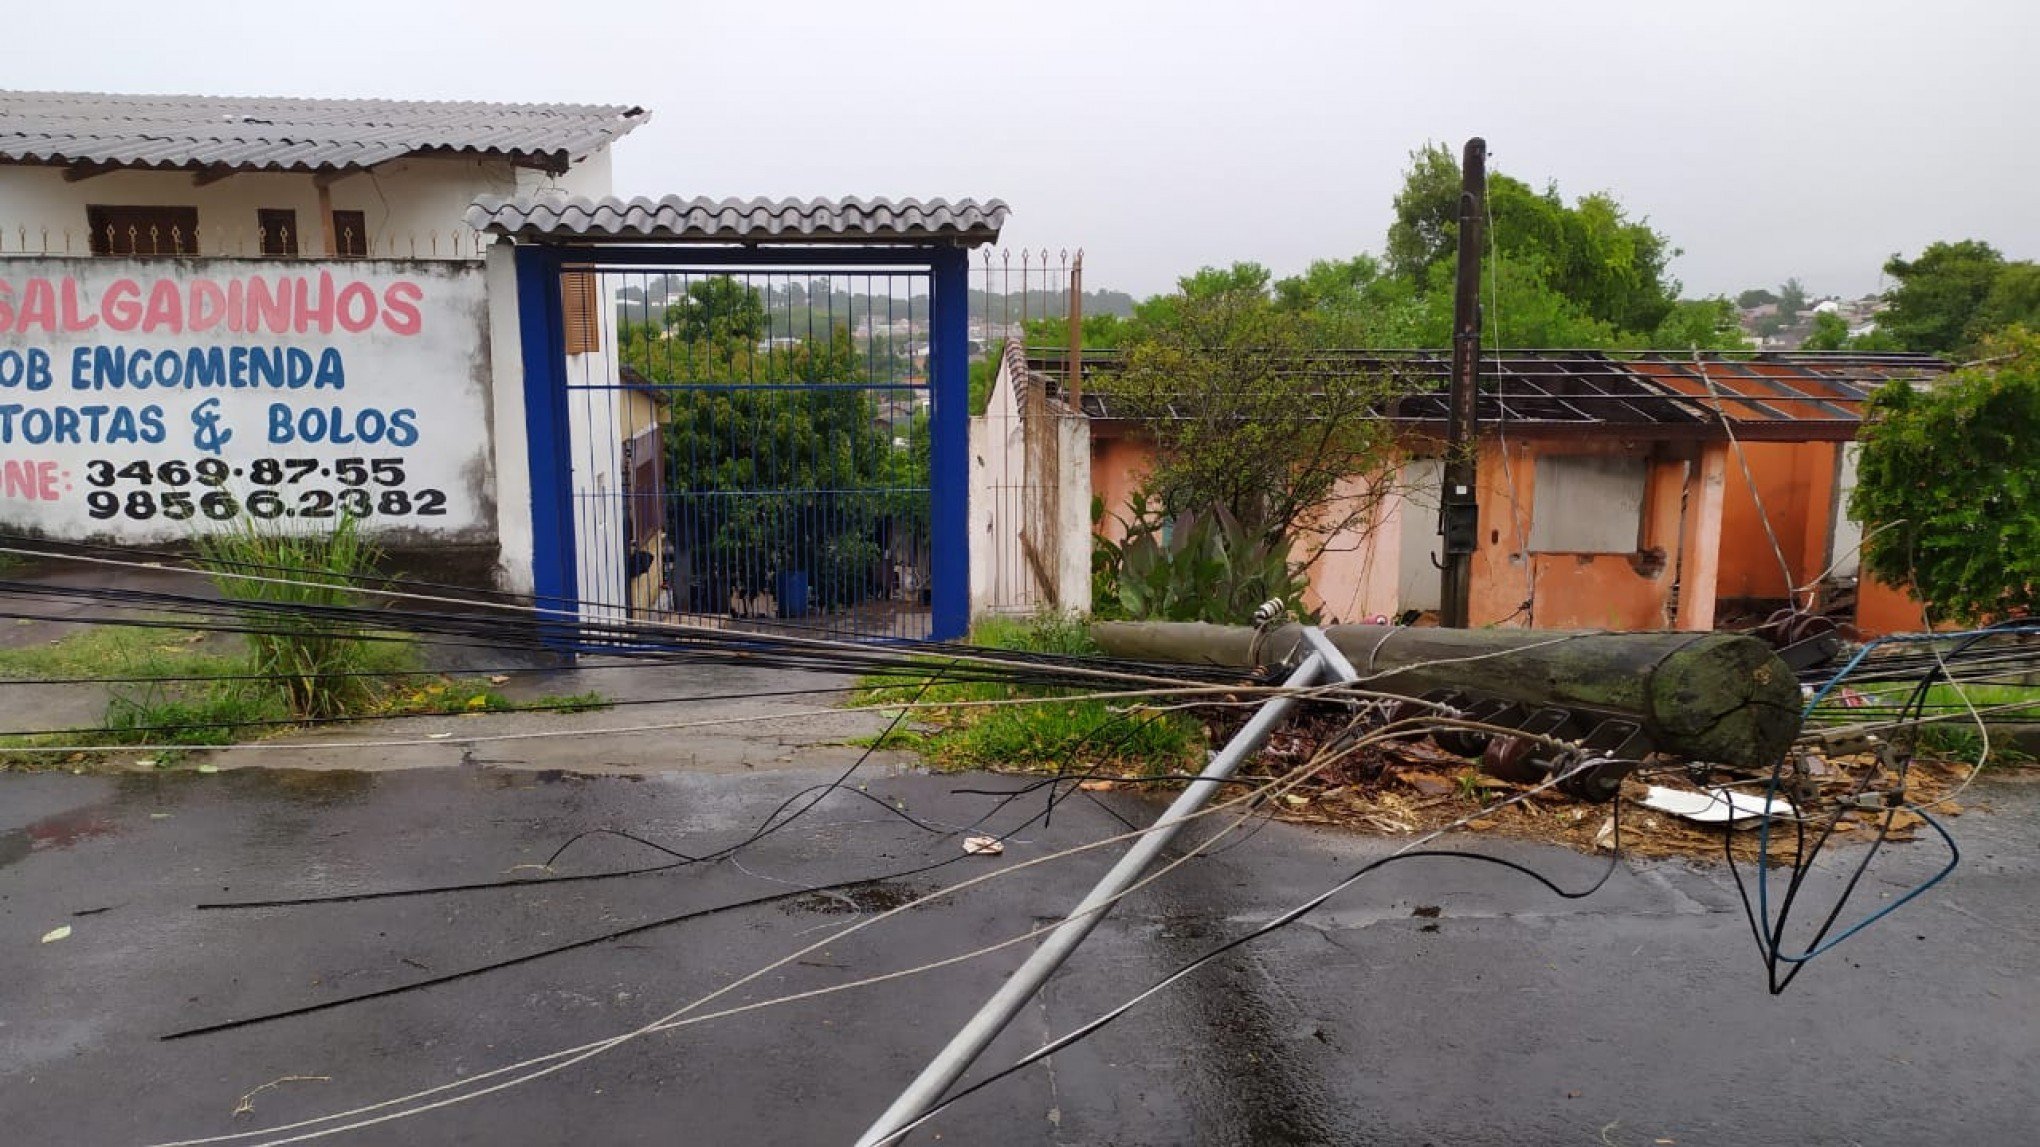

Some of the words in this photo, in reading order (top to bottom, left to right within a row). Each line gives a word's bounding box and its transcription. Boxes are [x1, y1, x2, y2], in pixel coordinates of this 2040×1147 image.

[71, 345, 345, 390] ENCOMENDA
[0, 403, 166, 444] TORTAS
[191, 397, 232, 455] &
[268, 402, 419, 447] BOLOS
[0, 459, 73, 501] NE:
